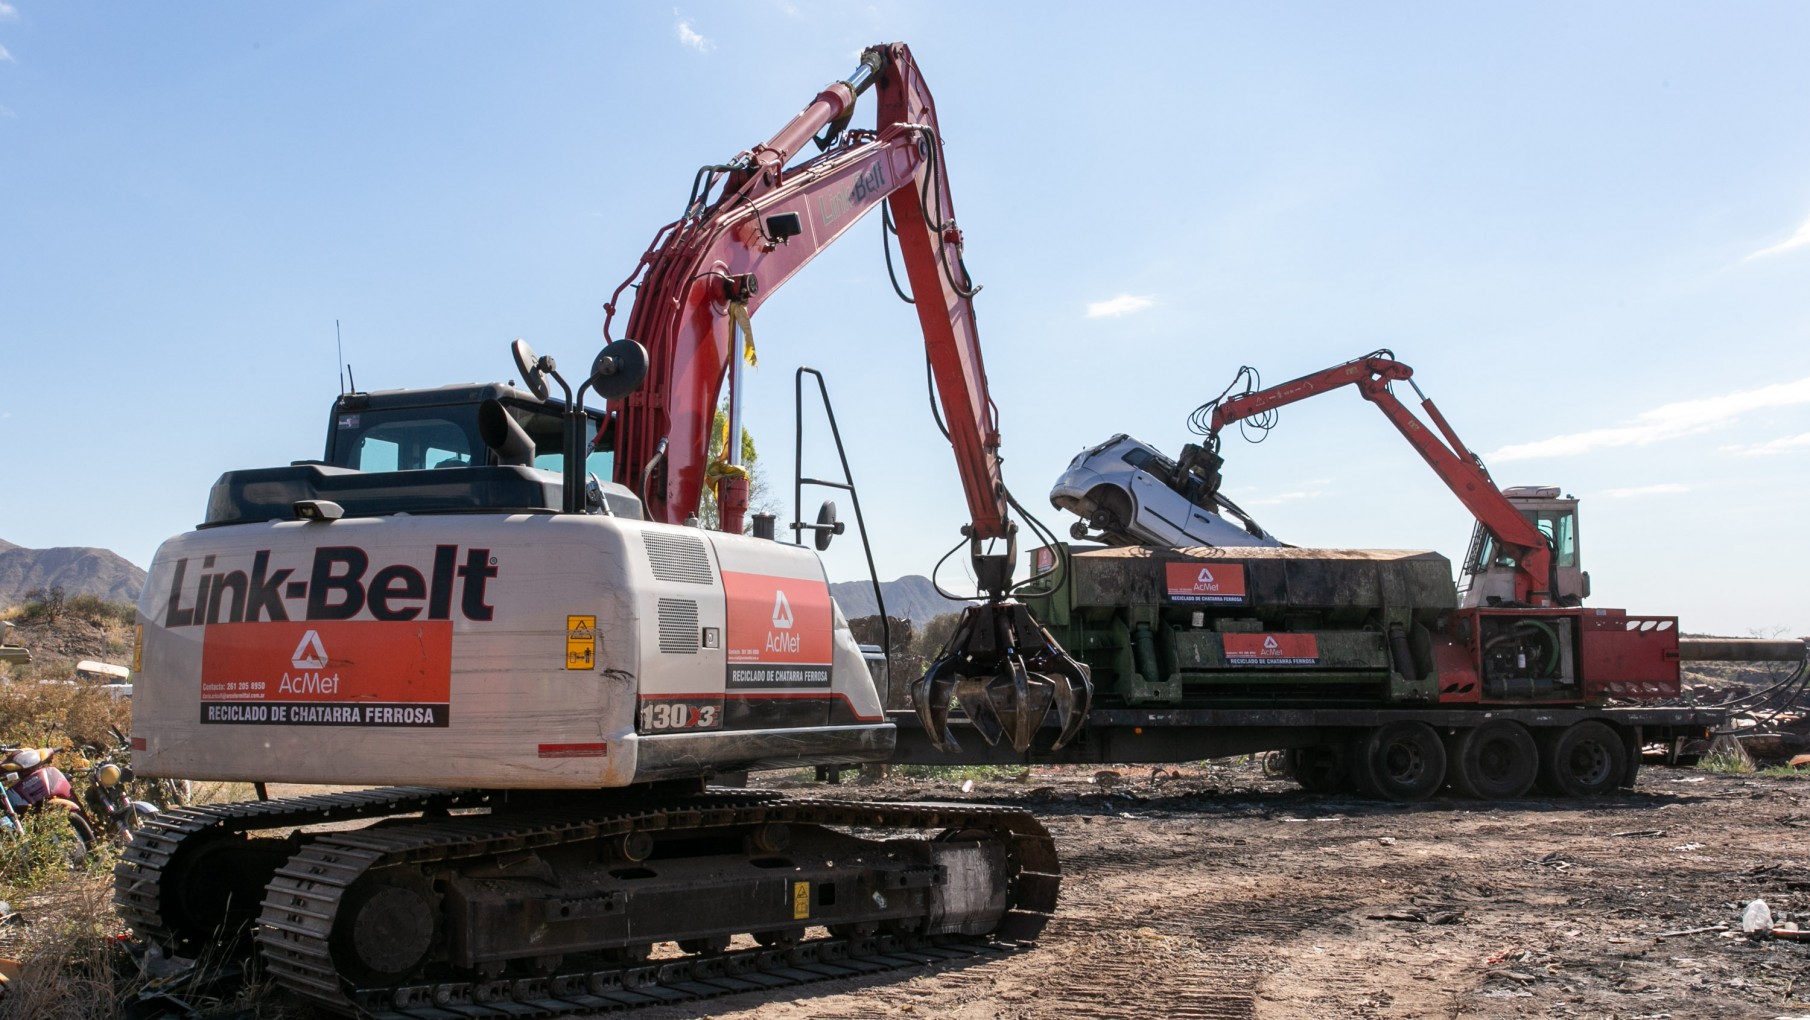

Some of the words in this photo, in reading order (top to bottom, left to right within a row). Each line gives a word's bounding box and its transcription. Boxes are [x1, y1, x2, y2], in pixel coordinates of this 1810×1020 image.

[1194, 583, 1219, 591] AcMet
[766, 631, 801, 653] AcMet
[1260, 648, 1283, 656] AcMet
[732, 670, 765, 682] RECICLADO
[766, 670, 774, 681] DE
[775, 670, 803, 682] CHATARRA
[804, 670, 828, 682] FERROSA
[226, 682, 237, 690] 261
[238, 682, 249, 690] 205
[250, 681, 266, 690] 8950
[279, 672, 340, 694] AcMet
[208, 705, 268, 721] RECICLADO
[271, 706, 286, 721] DE
[290, 706, 361, 723] CHATARRA
[366, 707, 434, 724] FERROSA
